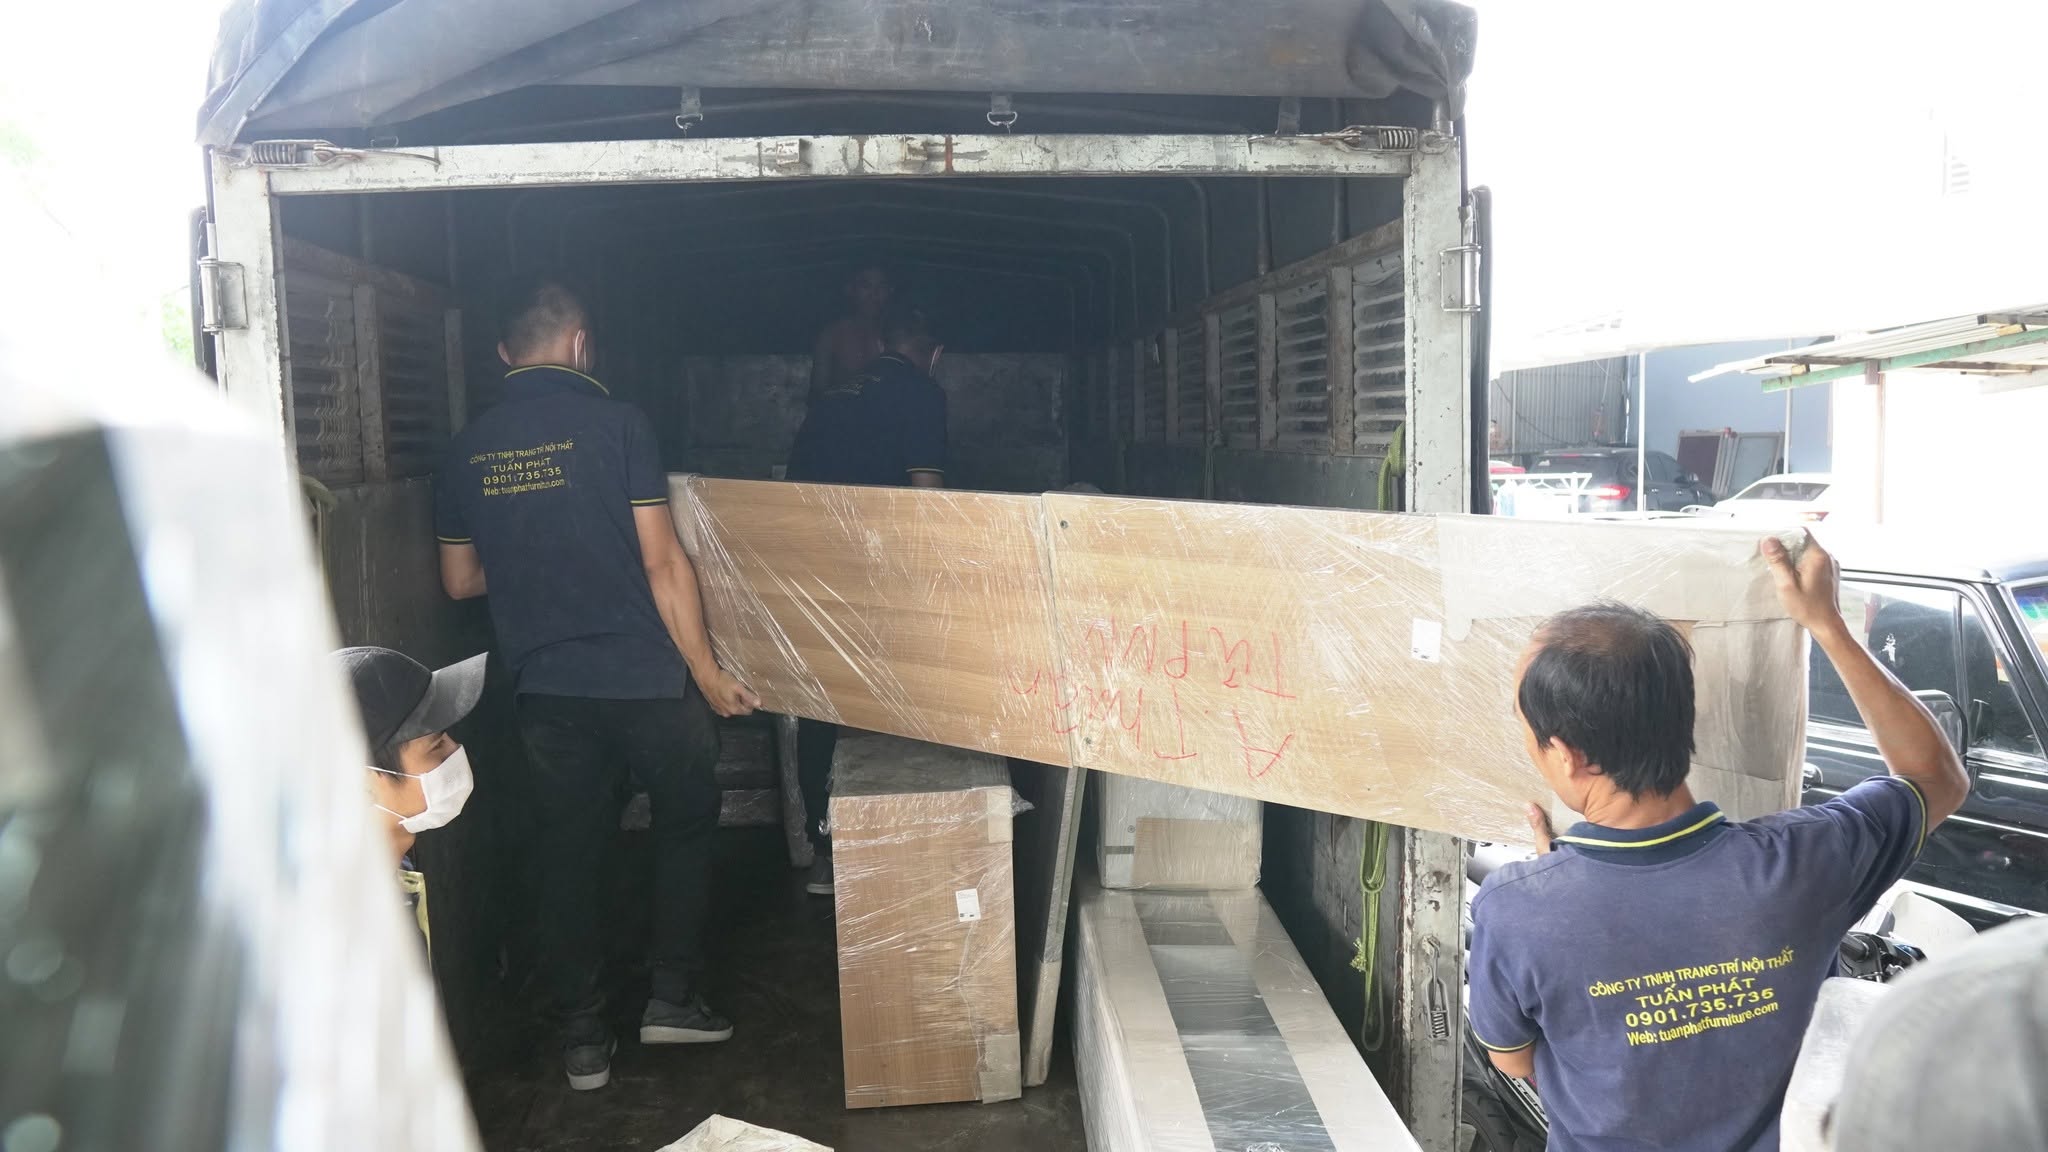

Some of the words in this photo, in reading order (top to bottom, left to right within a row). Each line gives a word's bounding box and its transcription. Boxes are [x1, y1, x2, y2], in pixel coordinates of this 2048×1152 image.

[487, 452, 496, 461] TY
[497, 450, 515, 460] TNHH
[515, 448, 537, 458] TRANG
[490, 458, 523, 473] TUẤN
[525, 457, 551, 470] PHÁT
[1588, 980, 1625, 998] CÔNG
[1624, 977, 1641, 991] TY
[1642, 970, 1676, 988] TNHH
[1675, 964, 1719, 981] TRANG
[1718, 957, 1739, 975] TRÍ
[1741, 956, 1765, 974] NỘI
[1766, 945, 1794, 969] THẤT
[1625, 988, 1775, 1028] 0901.735.735
[1634, 982, 1693, 1009] TUẤN
[1697, 976, 1756, 998] PHÁT
[1658, 1001, 1779, 1041] tuanphatfurniture.com
